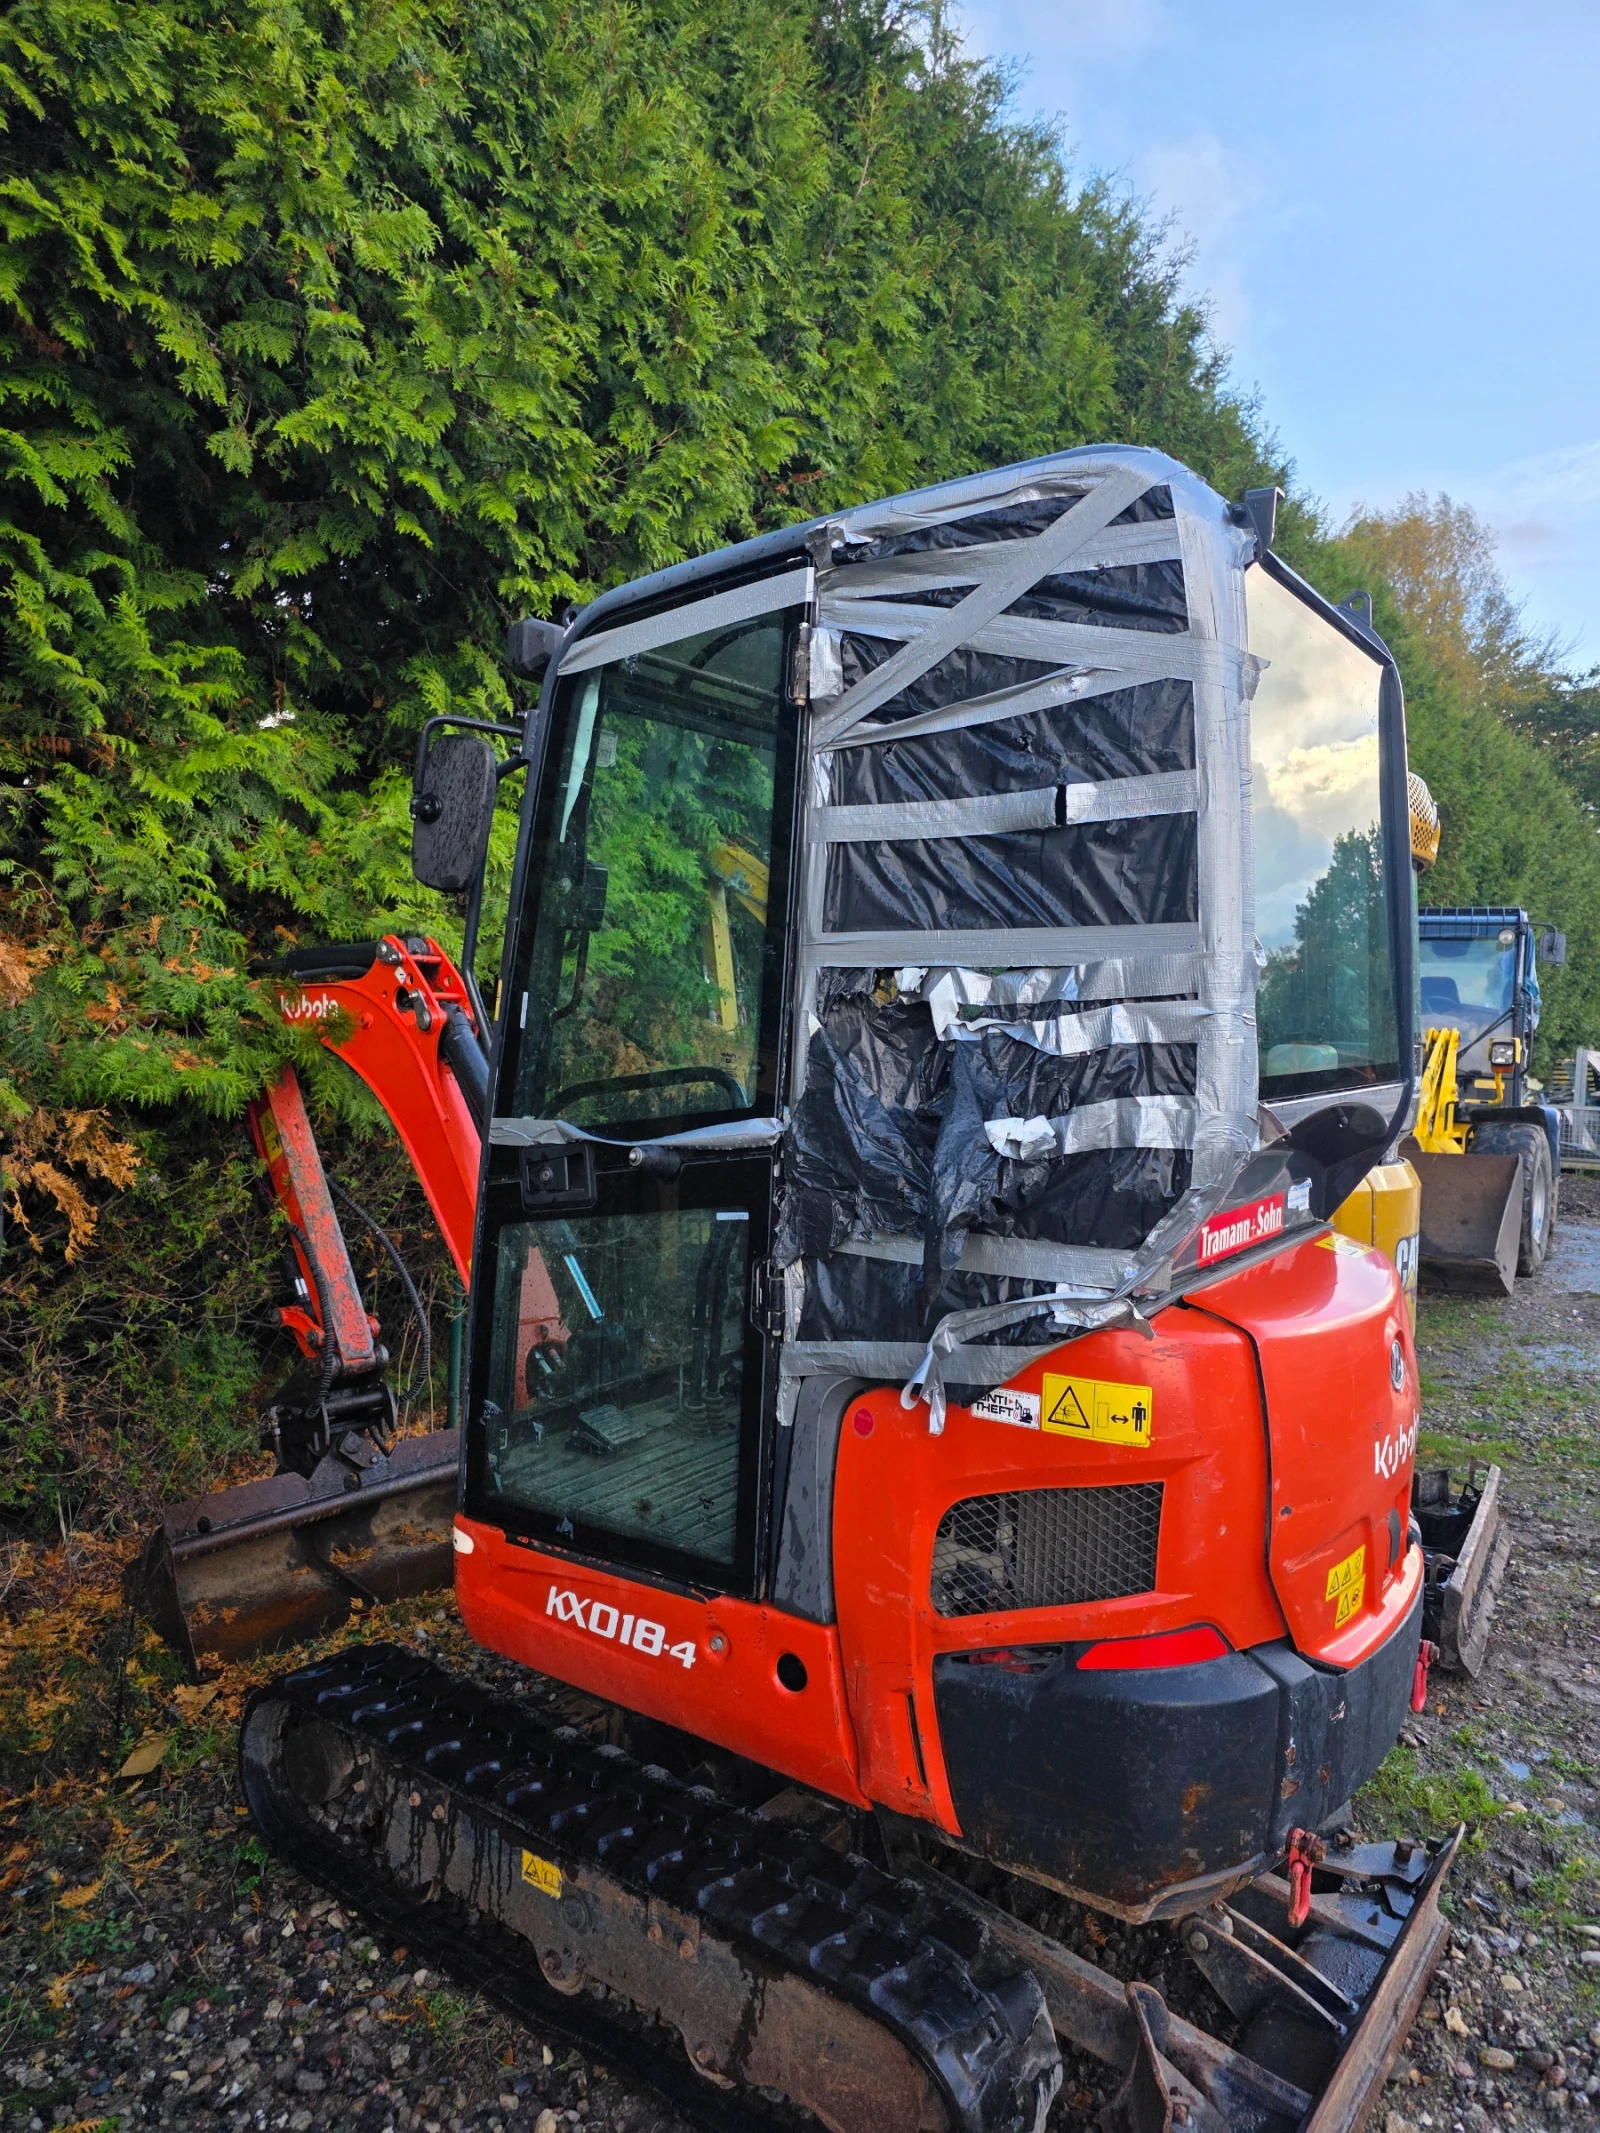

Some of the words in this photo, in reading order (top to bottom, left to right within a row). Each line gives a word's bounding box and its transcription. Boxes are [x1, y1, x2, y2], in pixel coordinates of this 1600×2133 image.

[1202, 1219, 1250, 1258] Tramann
[1256, 1202, 1283, 1236] Sohn
[1397, 1233, 1420, 1288] CA
[976, 1401, 1014, 1417] THEFT
[545, 1585, 697, 1669] KX018-4
